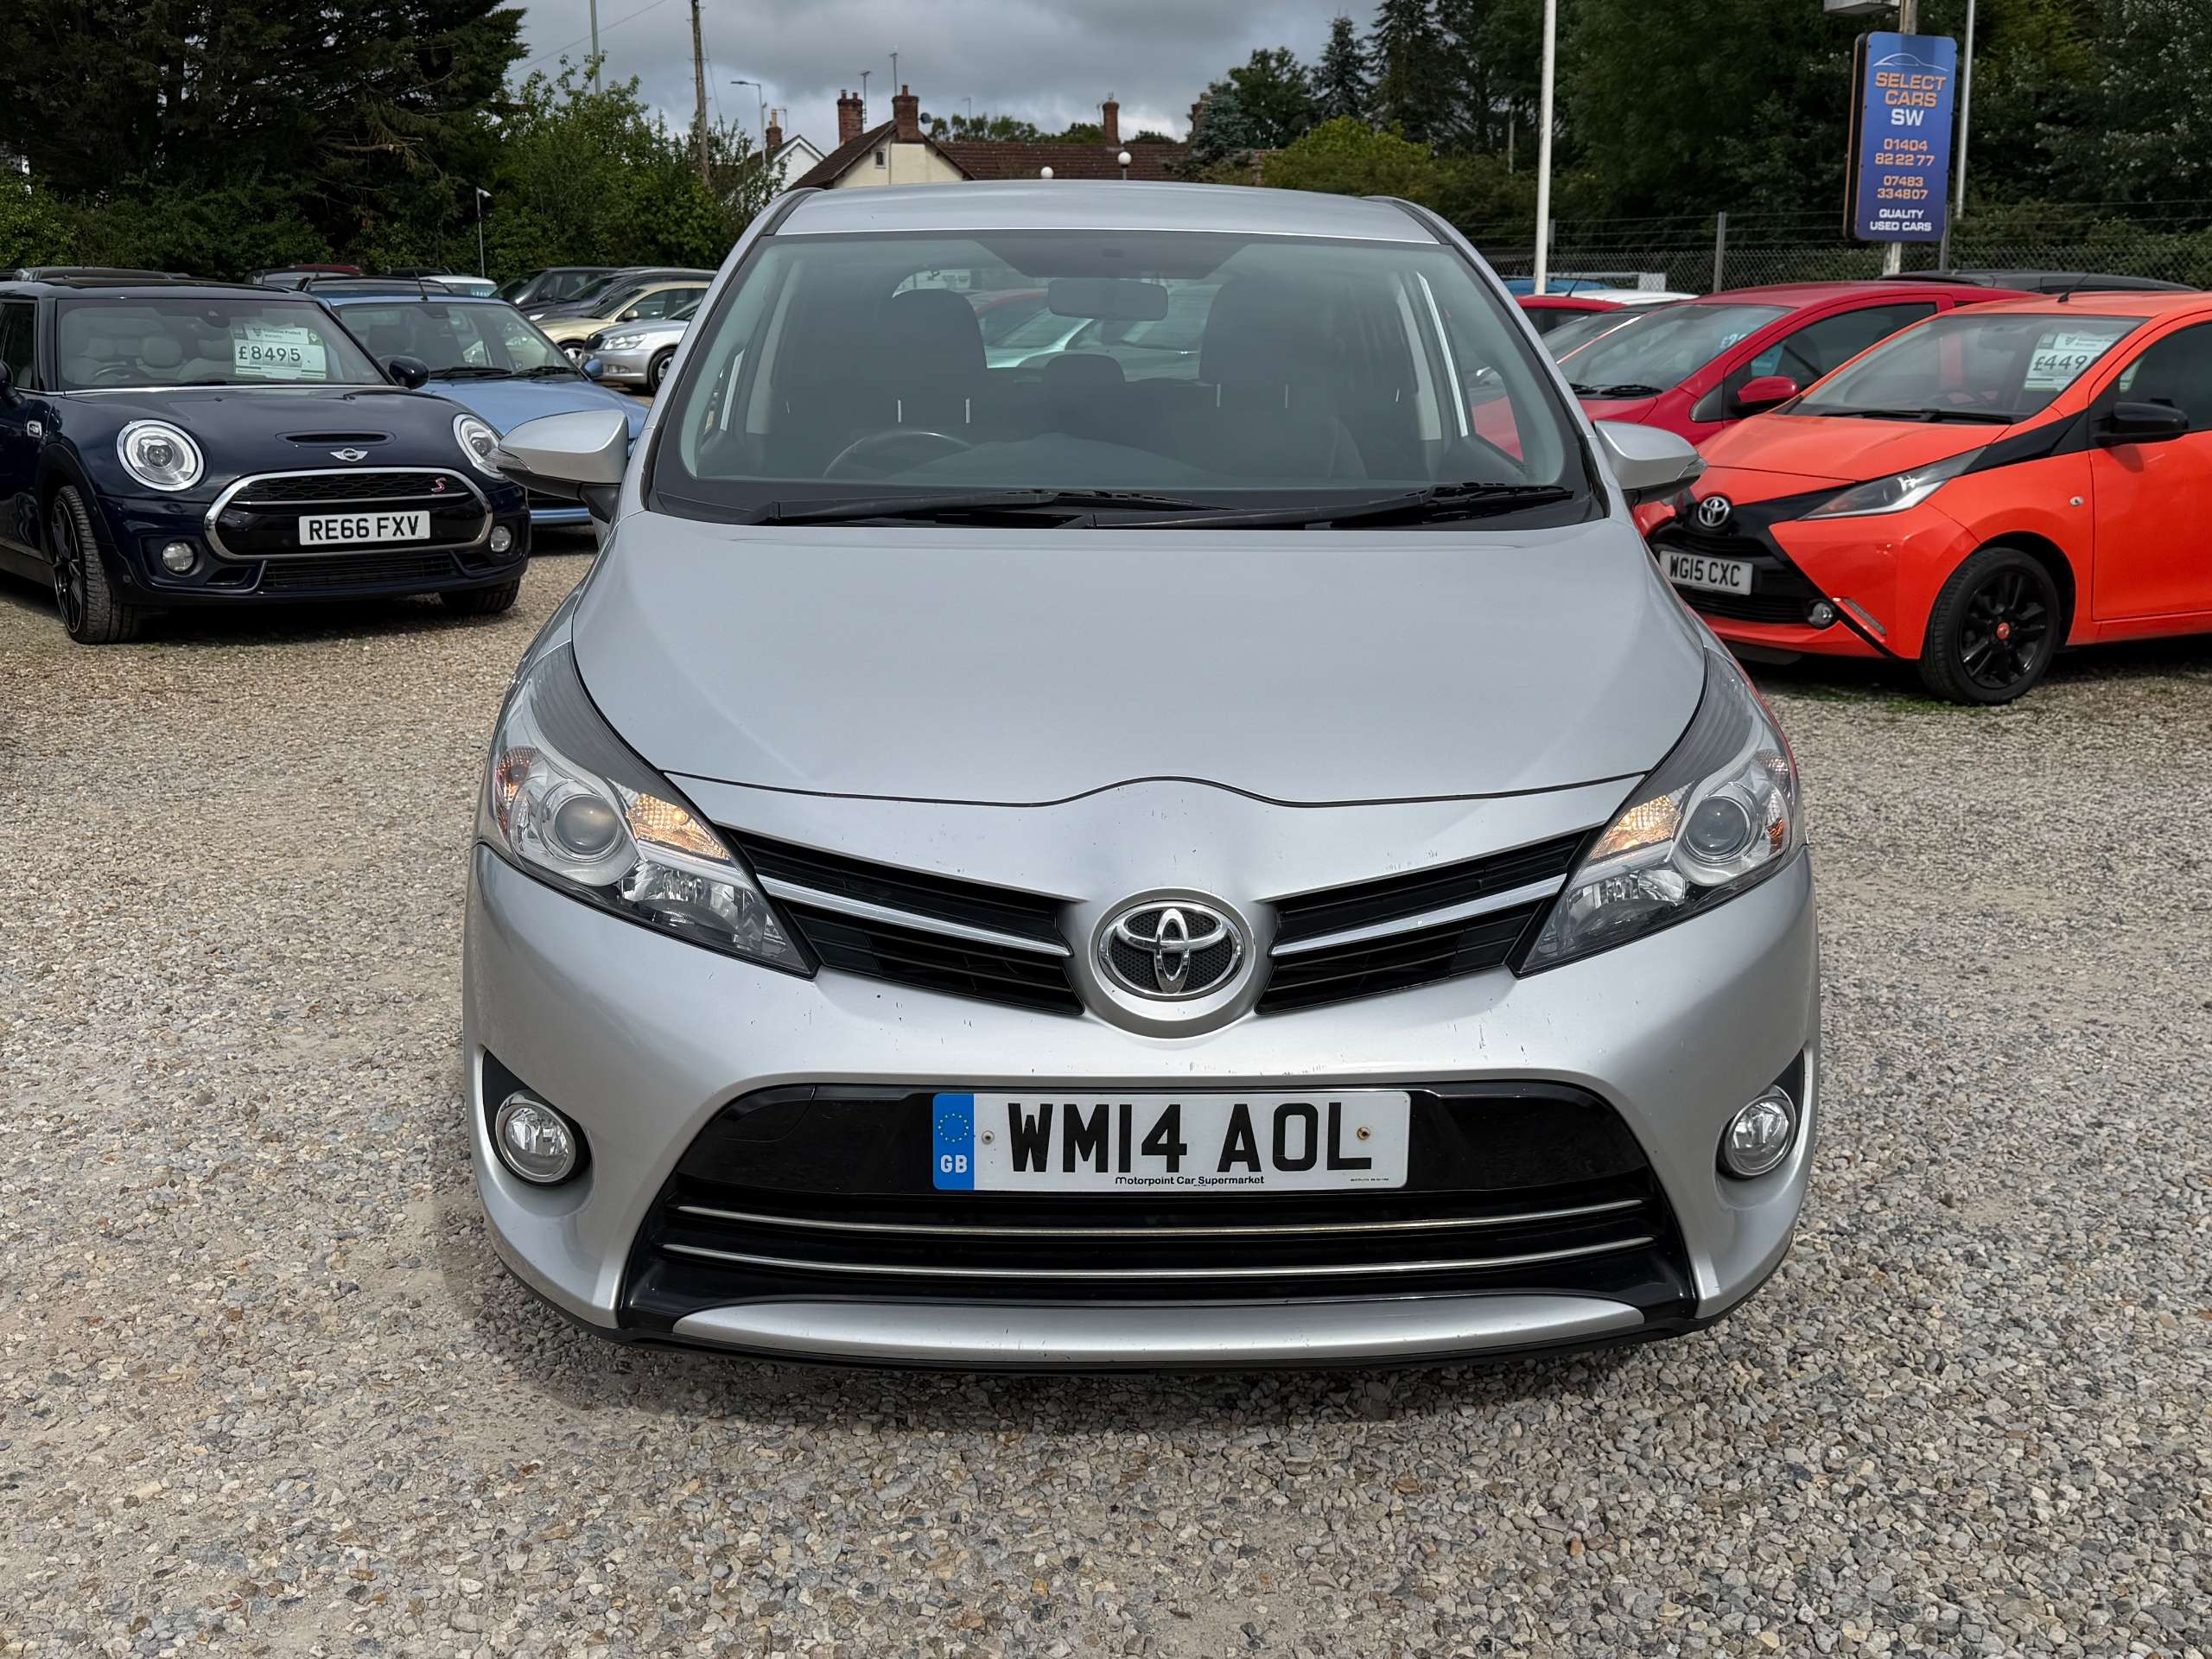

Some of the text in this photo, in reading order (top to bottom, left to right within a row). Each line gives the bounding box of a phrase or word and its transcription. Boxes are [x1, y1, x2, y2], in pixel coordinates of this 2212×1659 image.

[1875, 72, 1946, 92] SELECT
[1885, 90, 1937, 108] CARS
[1891, 108, 1924, 126] SW
[1884, 138, 1928, 151] 01404
[1884, 175, 1923, 187] 07483
[1878, 188, 1929, 200] 334807
[1879, 208, 1924, 219] QUALITY
[1870, 221, 1932, 232] USED CARS
[238, 346, 301, 362] £8495
[2032, 355, 2099, 372] £449
[309, 515, 419, 541] RE66 FXV
[1669, 555, 1740, 587] WG15 CXC
[1008, 1103, 1372, 1173] WM14 AOL
[940, 1154, 968, 1173] GB
[1115, 1176, 1265, 1186] Motorpoint Car Supermarket
